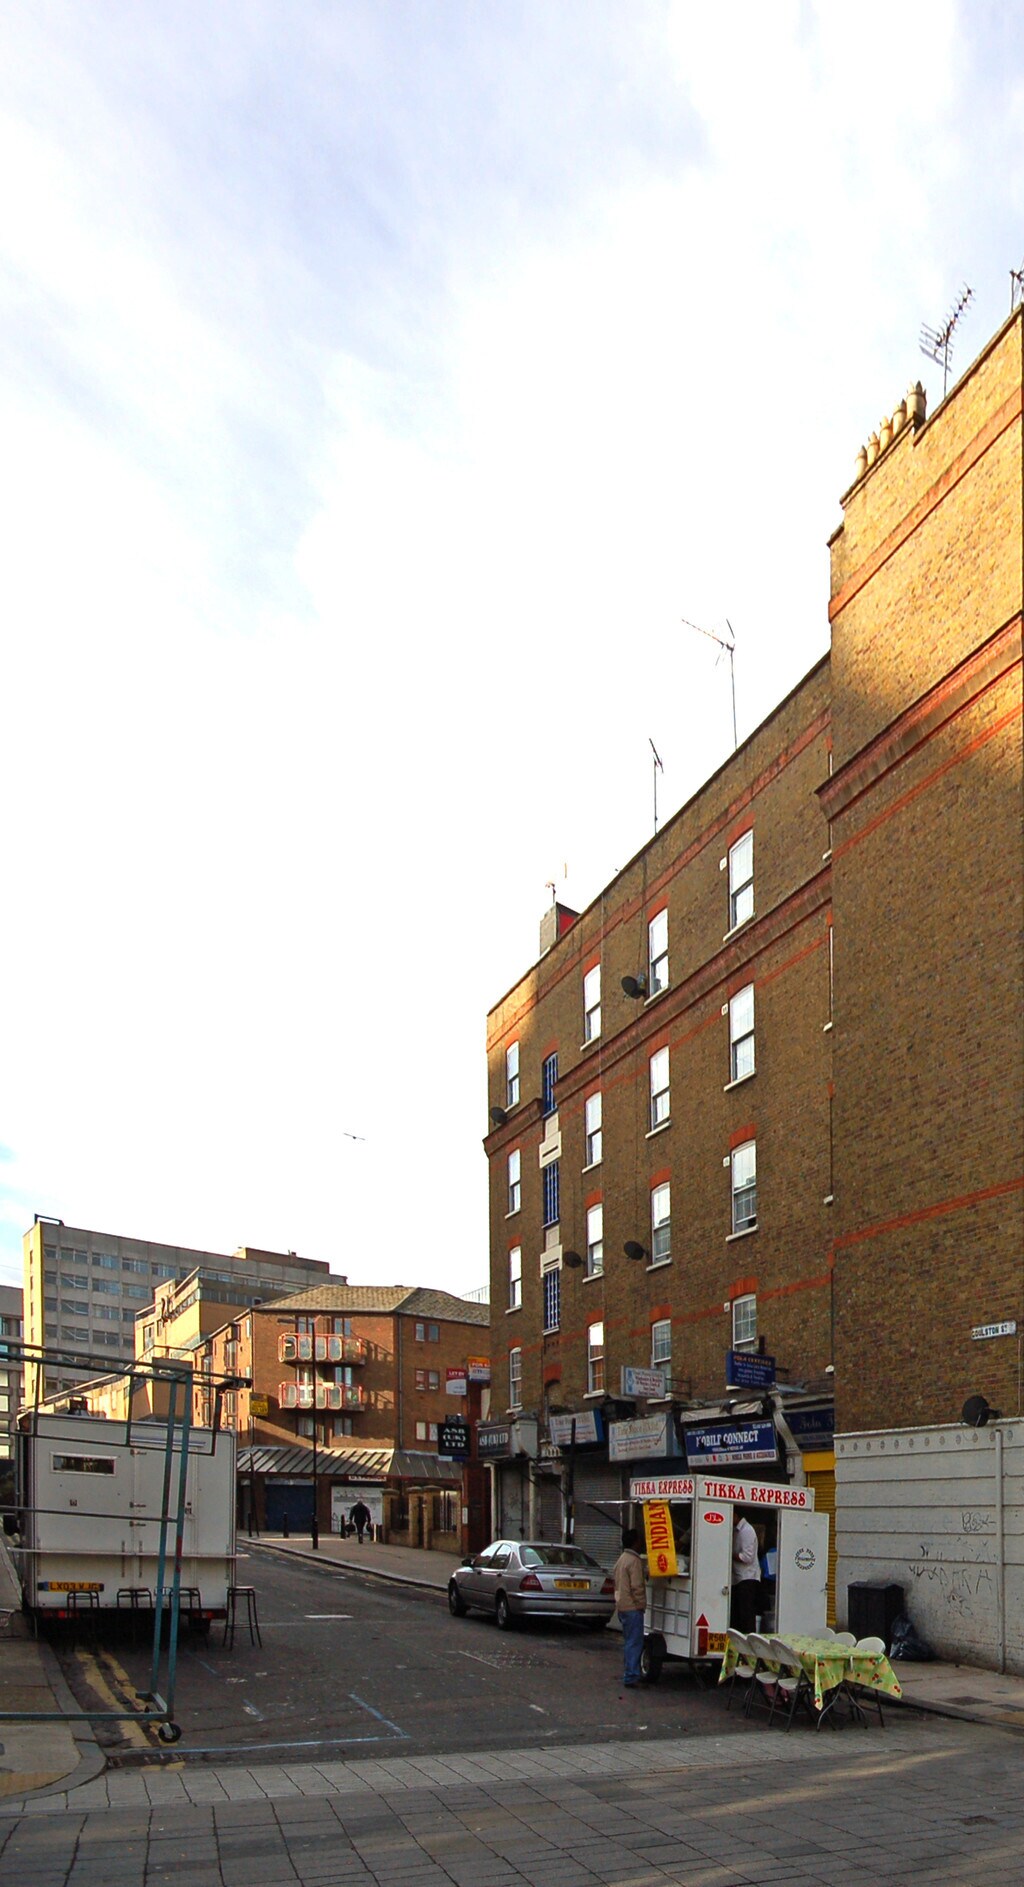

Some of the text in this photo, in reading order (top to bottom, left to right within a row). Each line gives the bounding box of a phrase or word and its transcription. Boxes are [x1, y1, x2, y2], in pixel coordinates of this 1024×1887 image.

[723, 1430, 759, 1445] CONNECT
[634, 1479, 693, 1495] TIKKA EXPRESS
[704, 1482, 806, 1507] TIKKA EXPRESS
[649, 1500, 670, 1550] INDIAN
